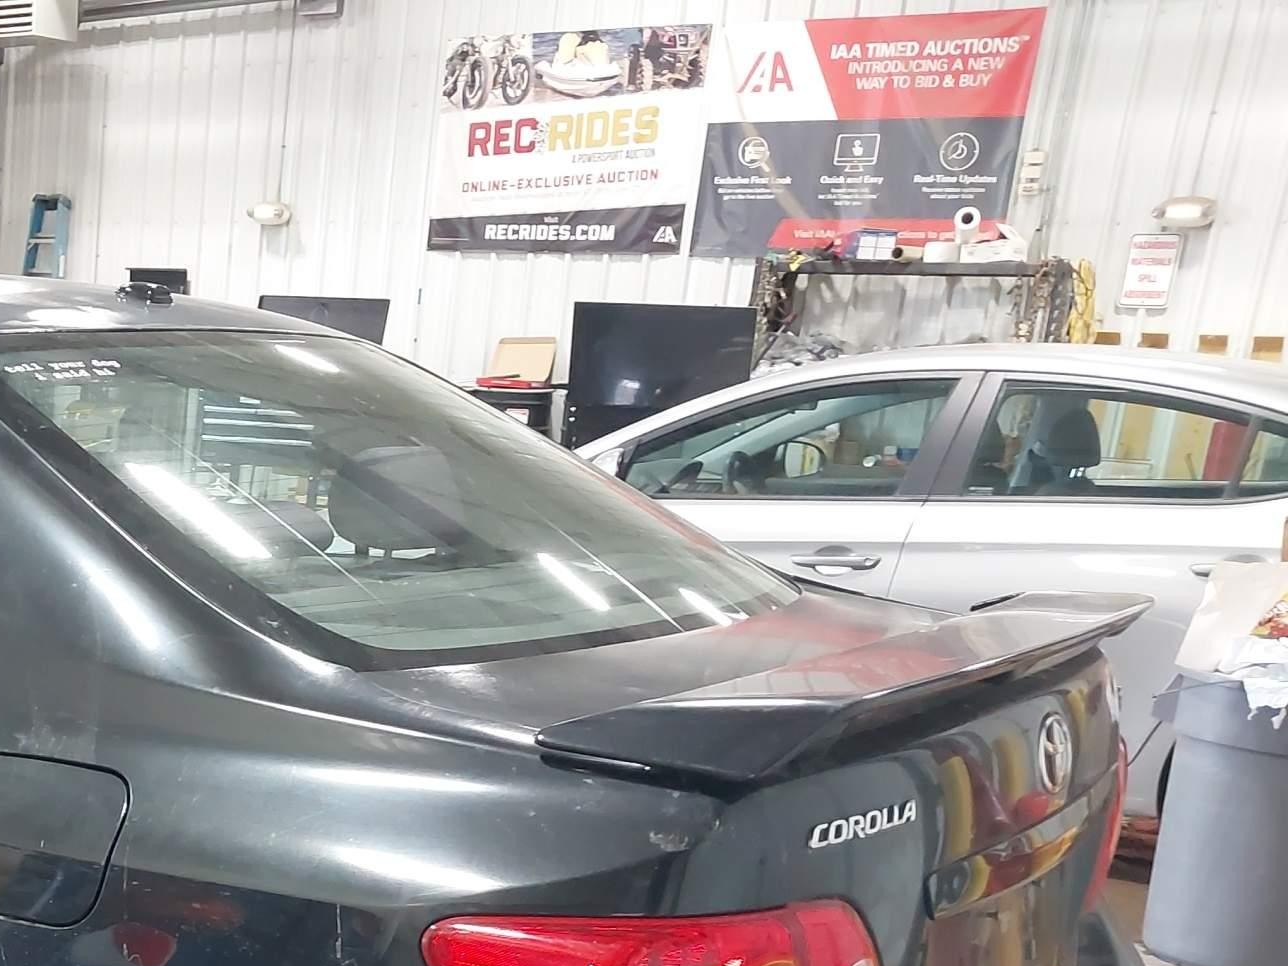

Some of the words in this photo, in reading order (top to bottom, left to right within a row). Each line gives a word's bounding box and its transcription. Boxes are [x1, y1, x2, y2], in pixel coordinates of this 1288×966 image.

[830, 43, 861, 59] IAA
[866, 41, 919, 59] TIMED
[848, 58, 948, 74] INTRODUCING
[952, 58, 963, 71] A
[968, 57, 1006, 70] NEW
[855, 76, 886, 90] WAY
[892, 75, 910, 88] TO
[915, 75, 940, 88] BID
[942, 75, 955, 88] &
[959, 73, 993, 88] BUY
[467, 117, 540, 158] REC
[548, 106, 661, 152] RIDES
[625, 148, 656, 159] AUCTION
[462, 174, 593, 193] ONLINE-EXCLUSIVE
[597, 168, 659, 184] AUCTION
[713, 176, 750, 185] Exclusive
[750, 176, 769, 185] First
[770, 176, 792, 185] Look
[819, 175, 844, 185] Quick
[846, 176, 862, 184] and
[863, 175, 884, 185] Easy
[913, 174, 958, 184] Real-Time
[959, 175, 998, 185] Updates
[484, 223, 616, 241] RECRIDES.COM
[48, 360, 86, 371] your
[808, 799, 917, 849] COROLLA
